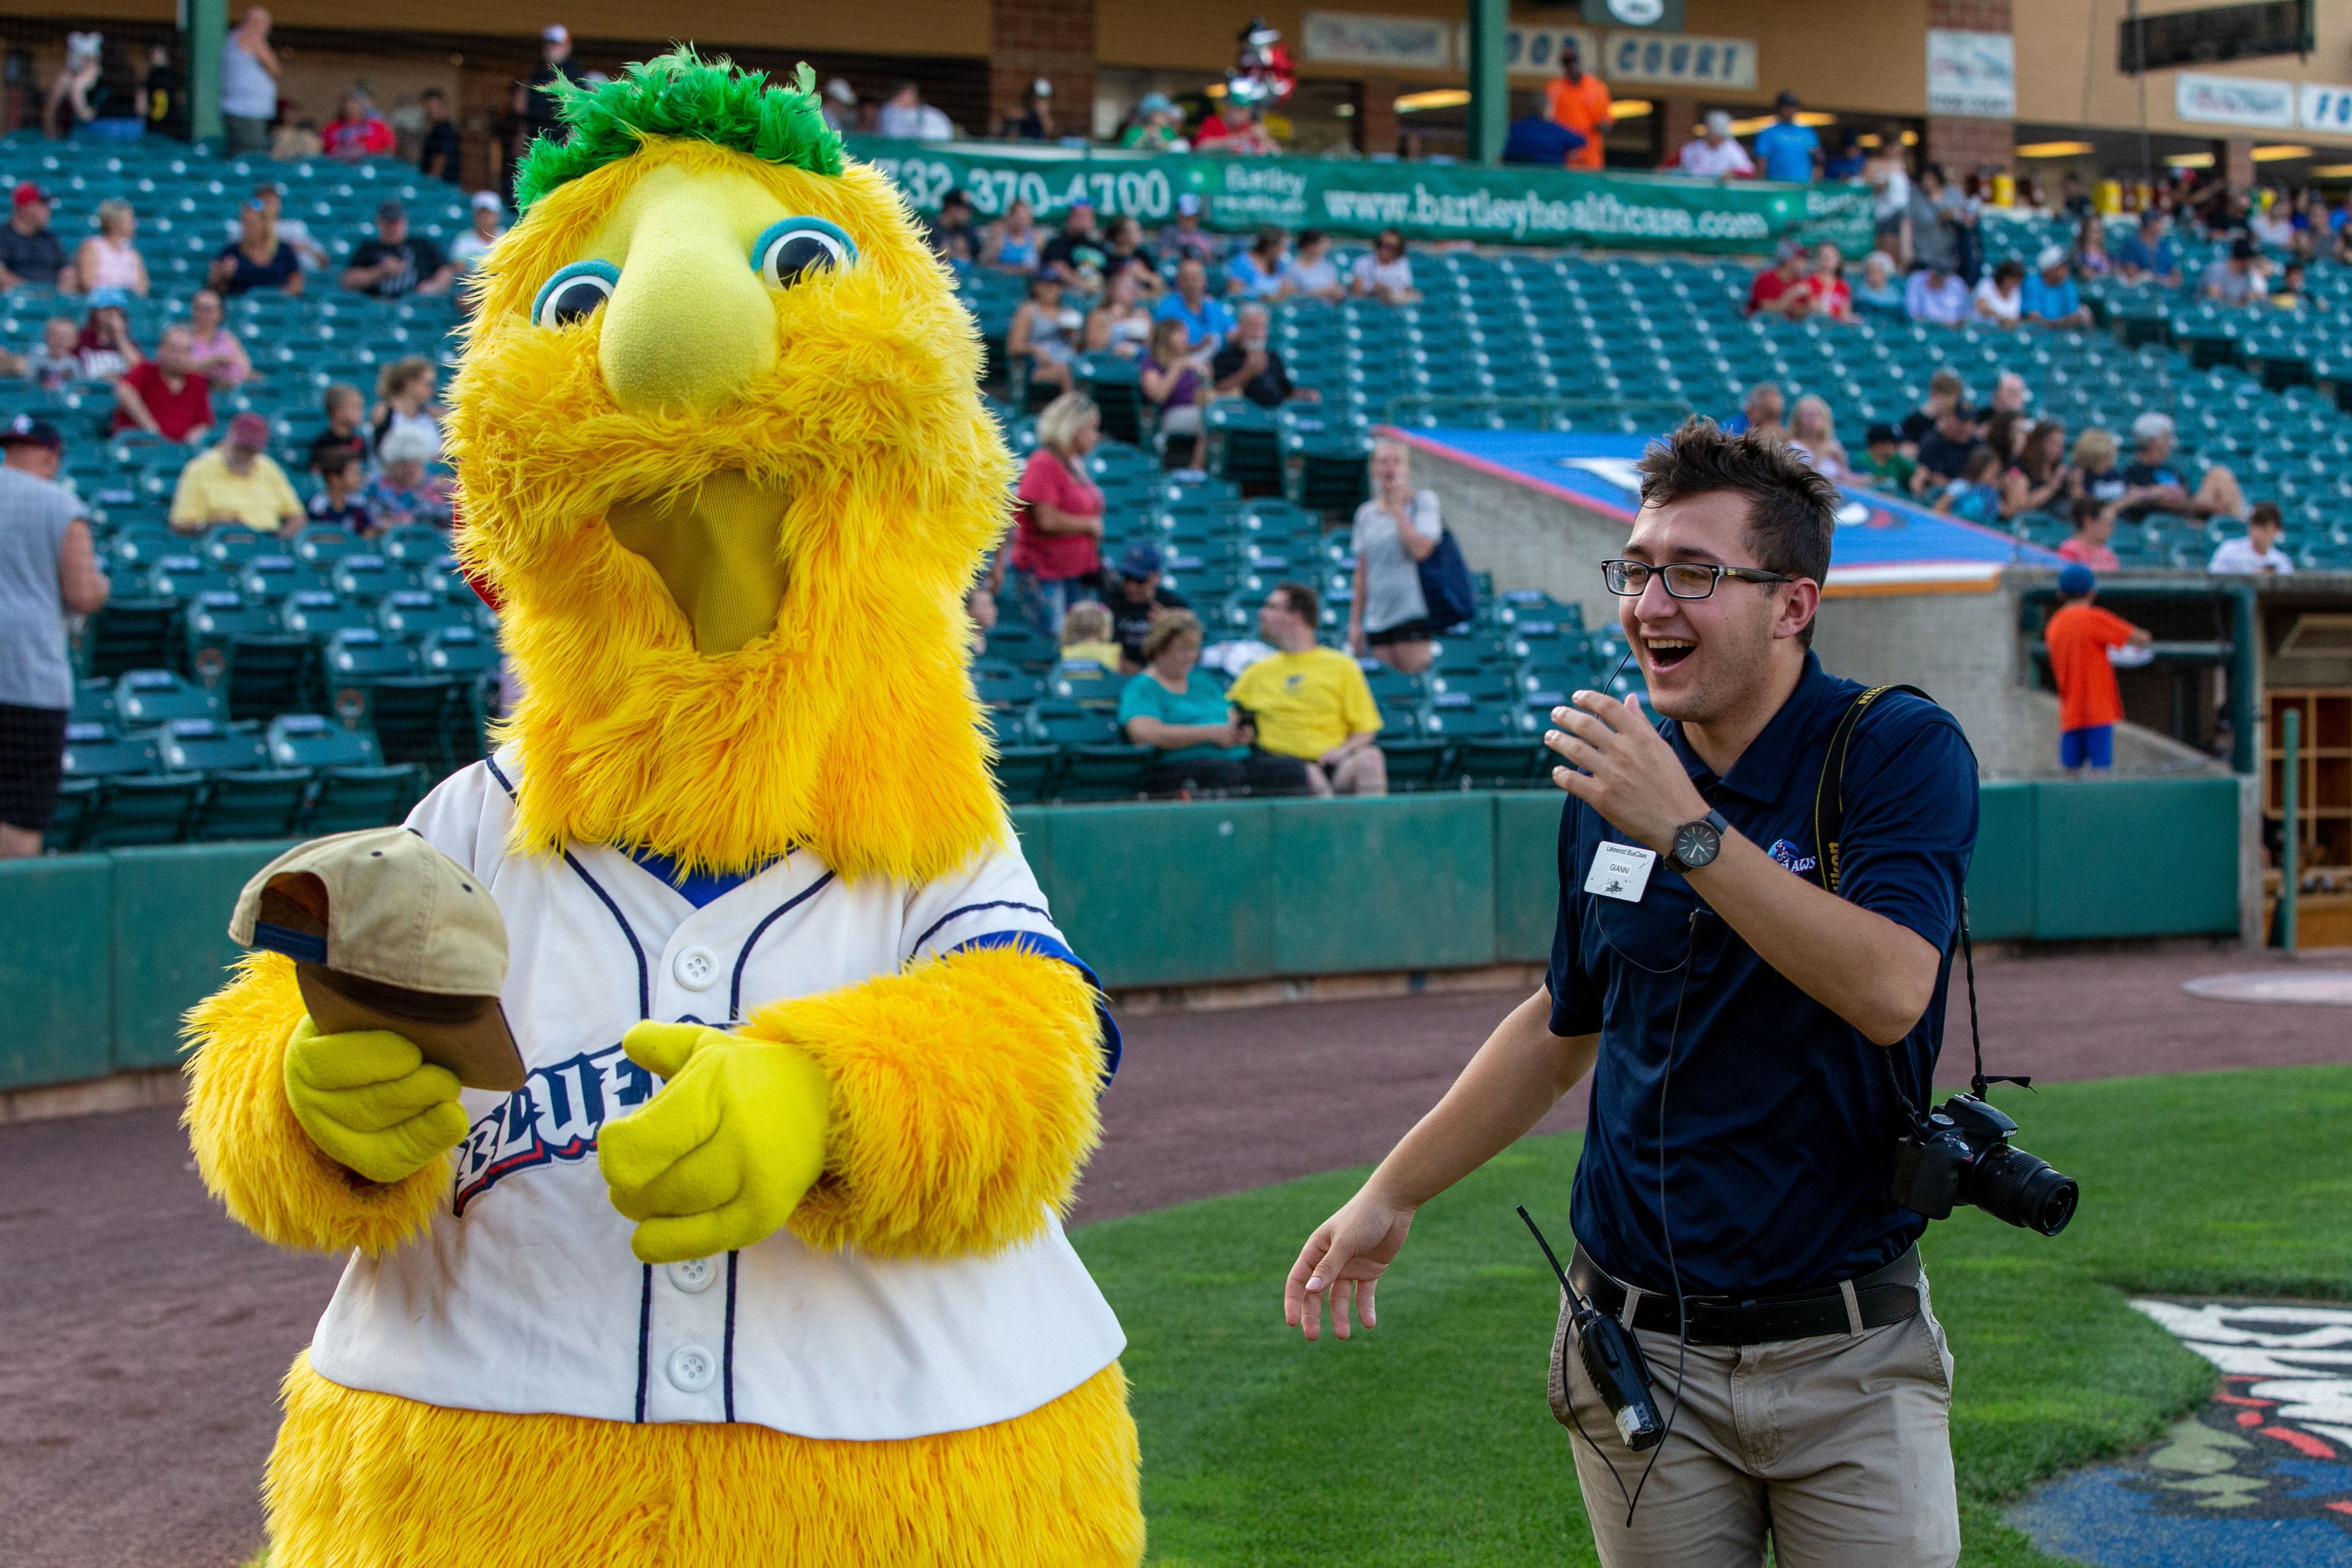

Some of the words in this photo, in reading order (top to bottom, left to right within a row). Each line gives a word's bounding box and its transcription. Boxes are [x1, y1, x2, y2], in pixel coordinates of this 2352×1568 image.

[1606, 846, 1626, 855] Lakewood
[1627, 850, 1647, 859] BlueClaws
[1610, 864, 1630, 874] GIANNI
[452, 1044, 656, 1217] BLUE
